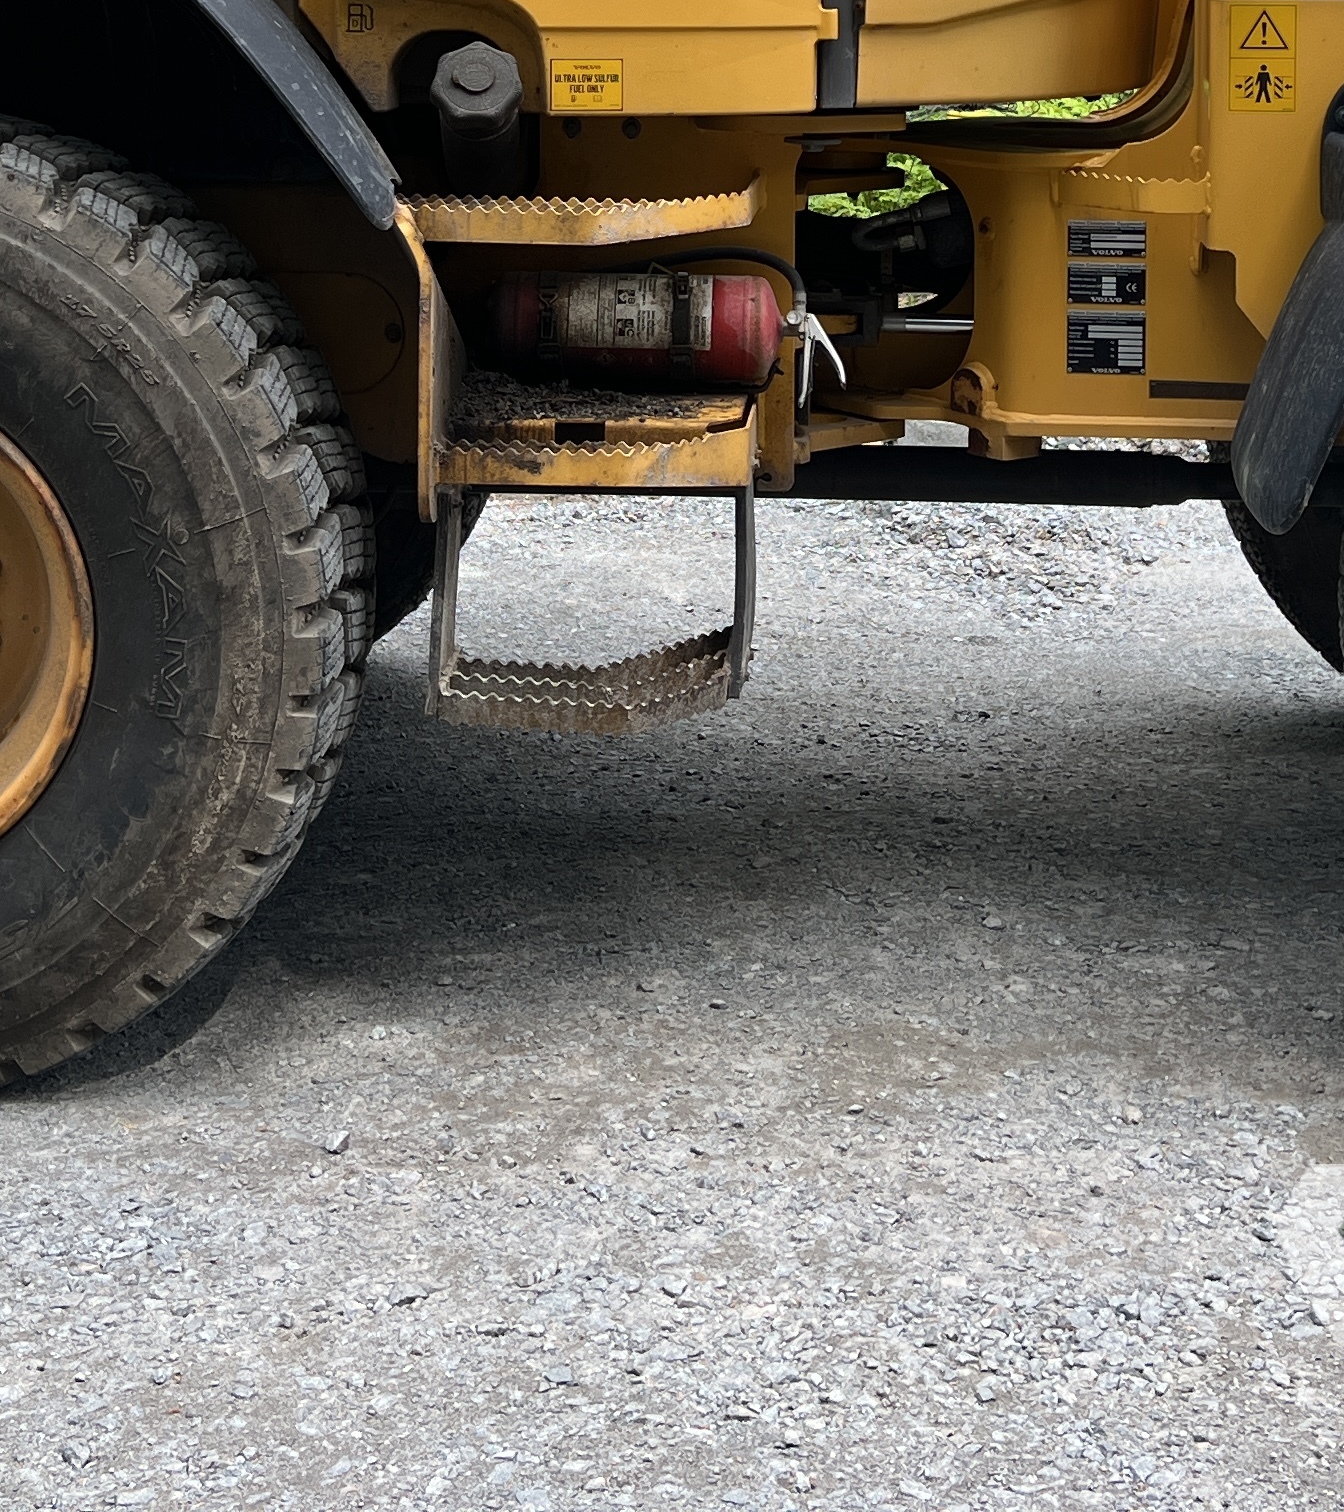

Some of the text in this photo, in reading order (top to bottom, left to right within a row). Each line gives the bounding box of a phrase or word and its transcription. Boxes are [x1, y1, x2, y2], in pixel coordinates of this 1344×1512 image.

[554, 73, 620, 83] ULTRA LOW SULFUR
[569, 84, 605, 94] FUEL ONLY
[1125, 282, 1138, 293] CE
[64, 380, 190, 721] MAXAM
